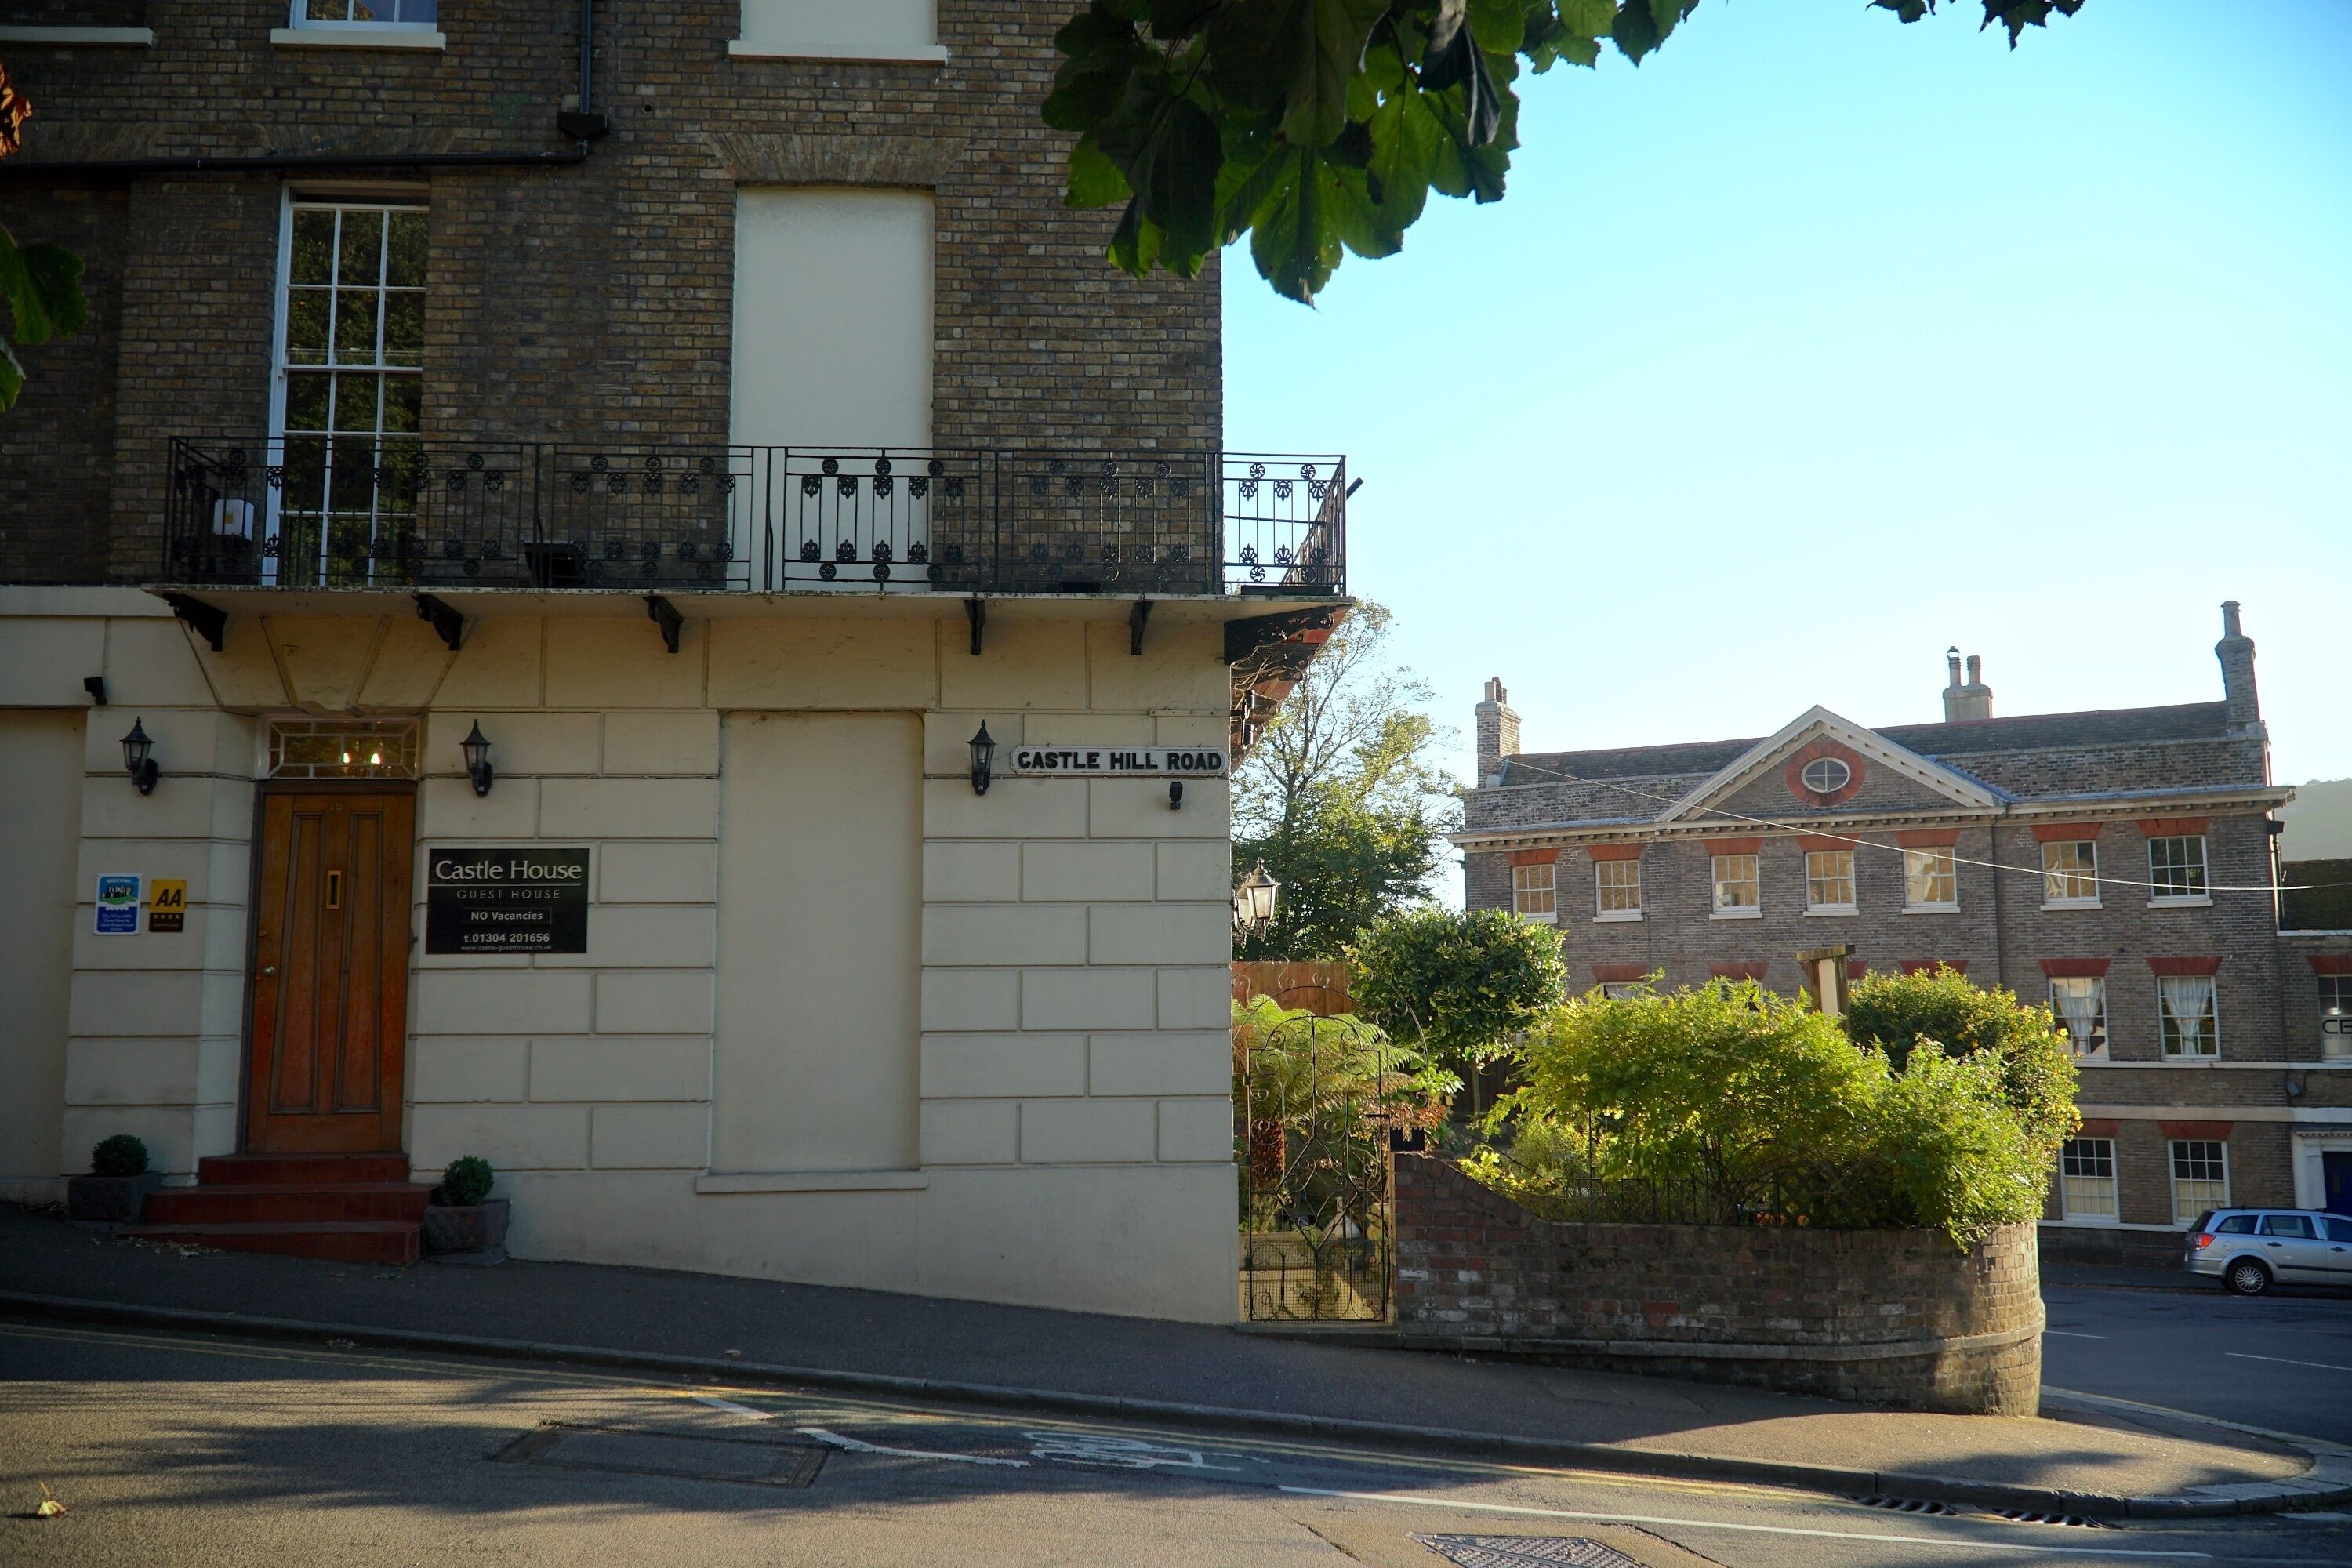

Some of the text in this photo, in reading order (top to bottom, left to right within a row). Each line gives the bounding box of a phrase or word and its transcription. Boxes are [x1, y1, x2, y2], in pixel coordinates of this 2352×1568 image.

[1018, 751, 1221, 770] CASTLE HILL ROAD
[435, 859, 582, 880] Castle House
[155, 888, 181, 906] AA
[456, 889, 561, 899] GUEST HOUSE
[470, 911, 543, 920] NO Vacancies
[463, 932, 550, 943] t.01304 201656
